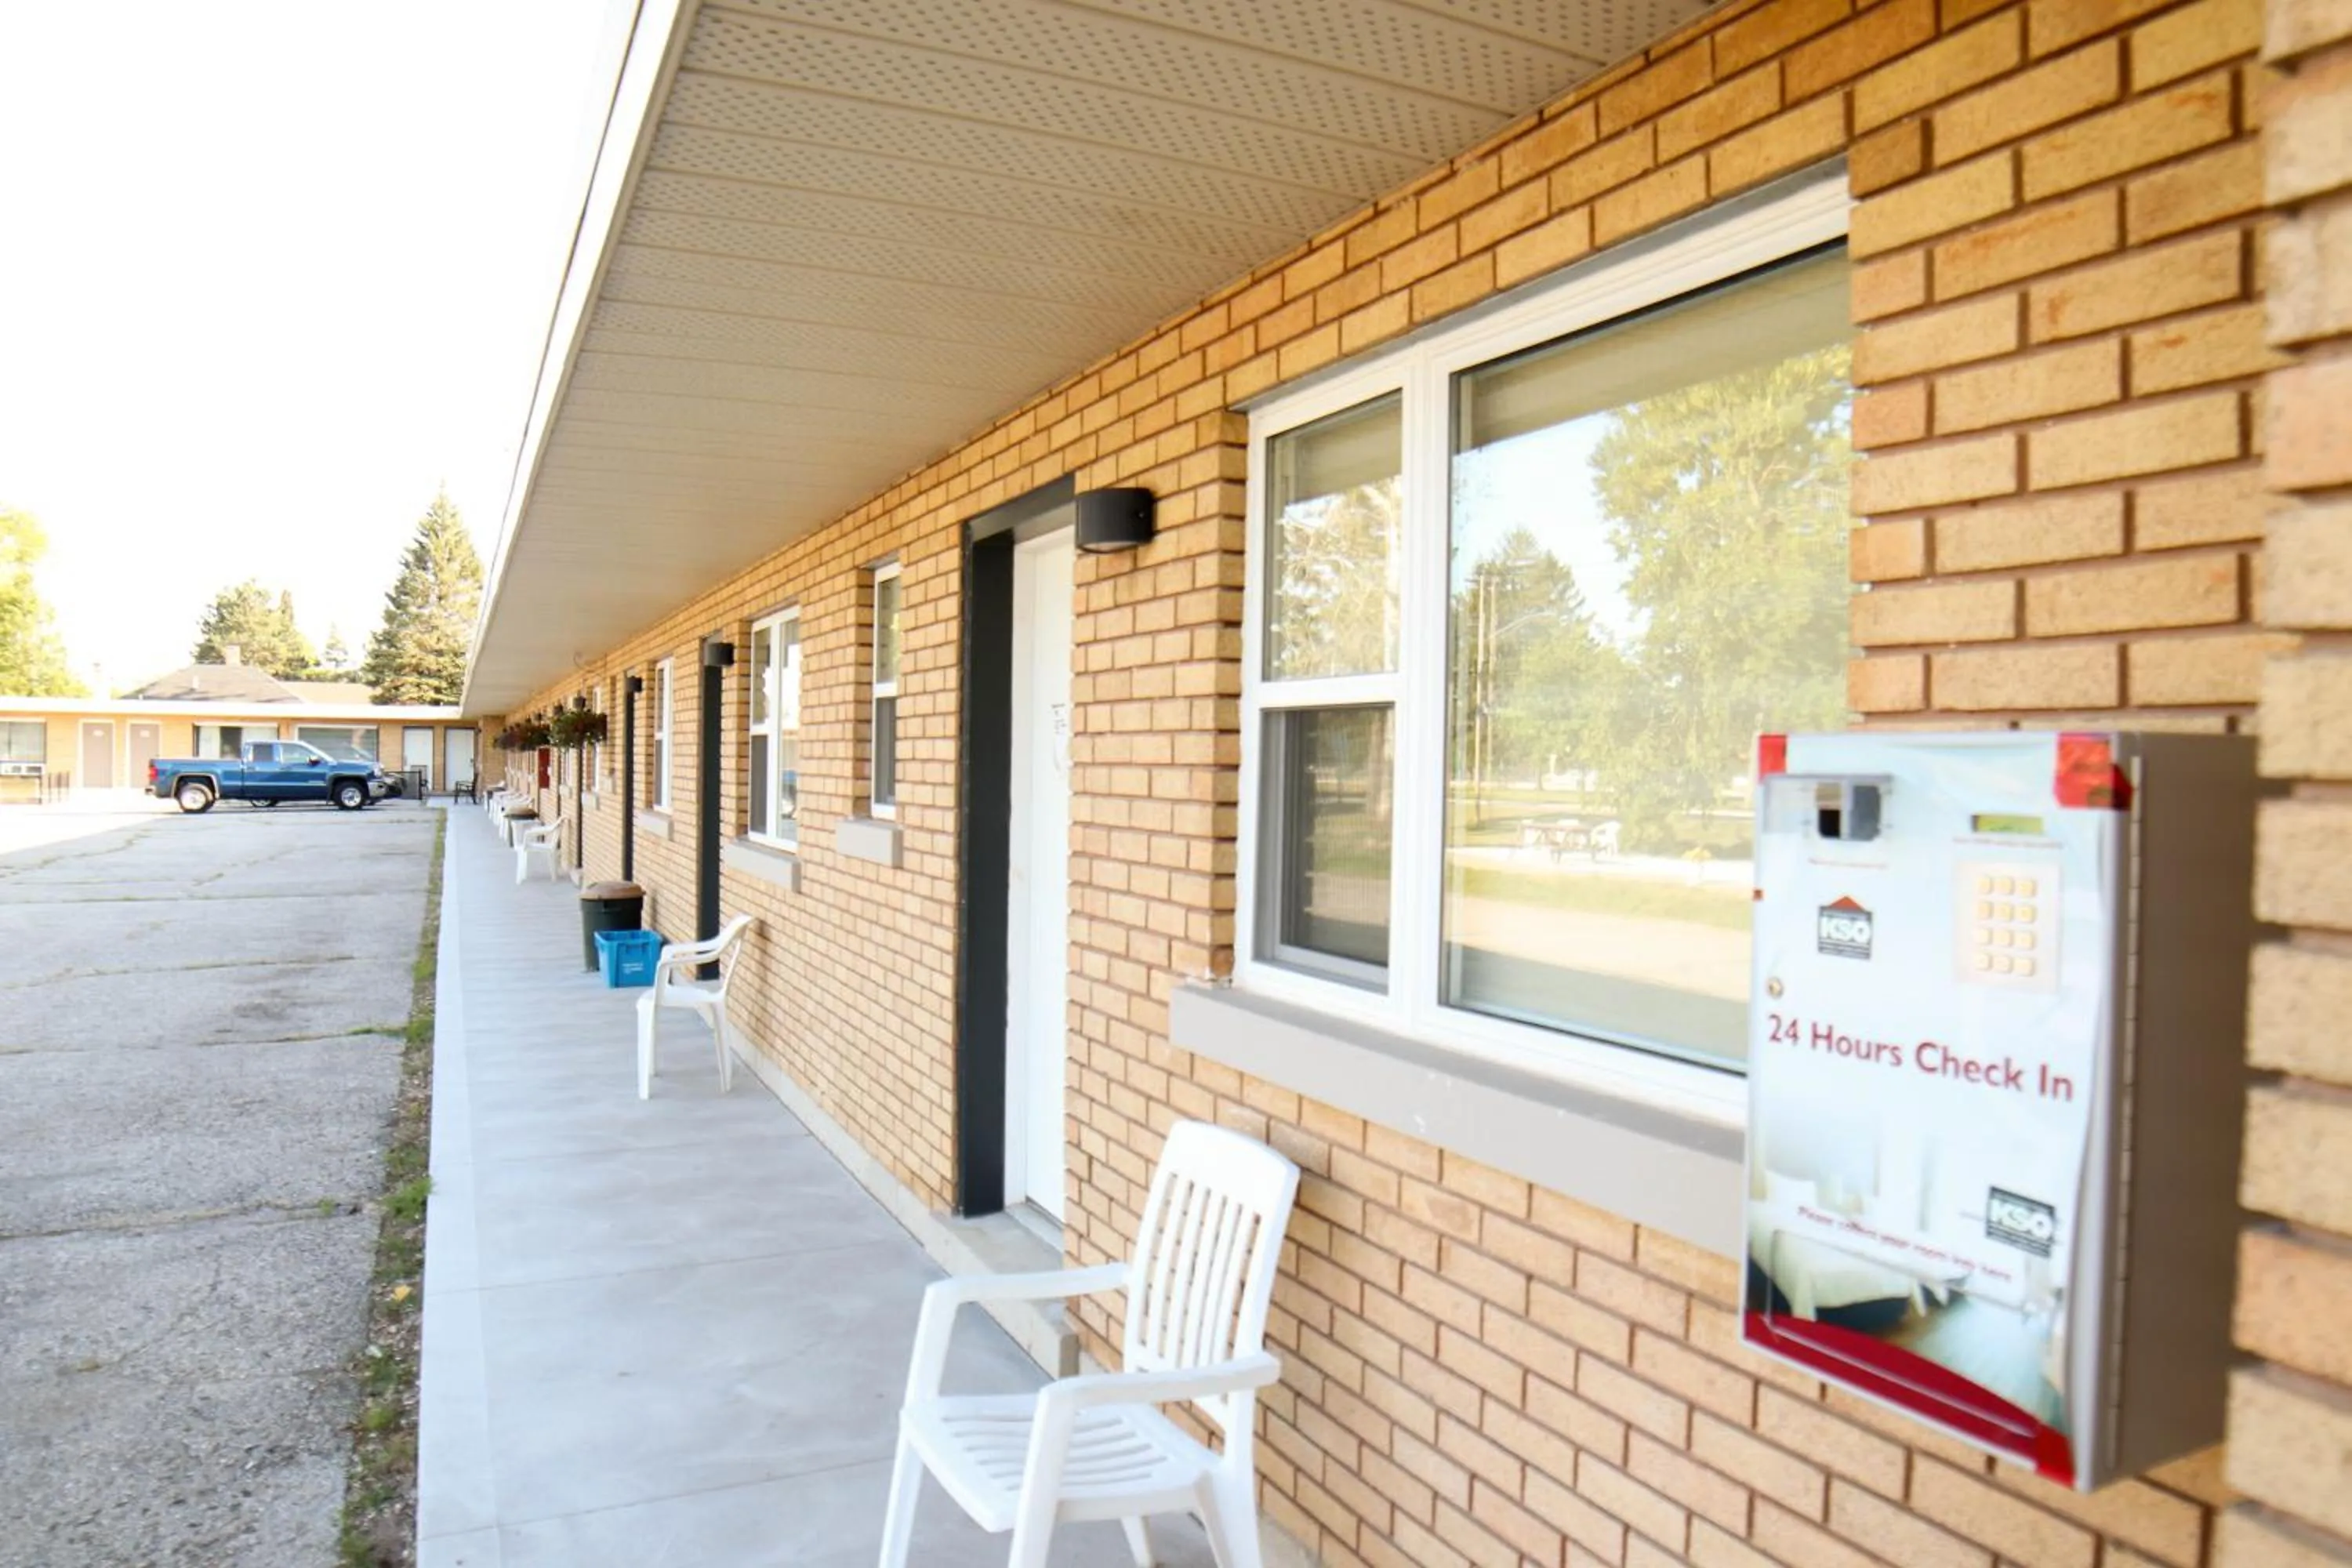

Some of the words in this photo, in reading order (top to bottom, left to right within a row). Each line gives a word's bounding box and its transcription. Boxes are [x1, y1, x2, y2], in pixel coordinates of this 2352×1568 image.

[1768, 1013, 1799, 1047] 24
[1810, 1021, 1904, 1068] Hours
[1915, 1041, 2024, 1092] Check
[2039, 1063, 2074, 1102] In
